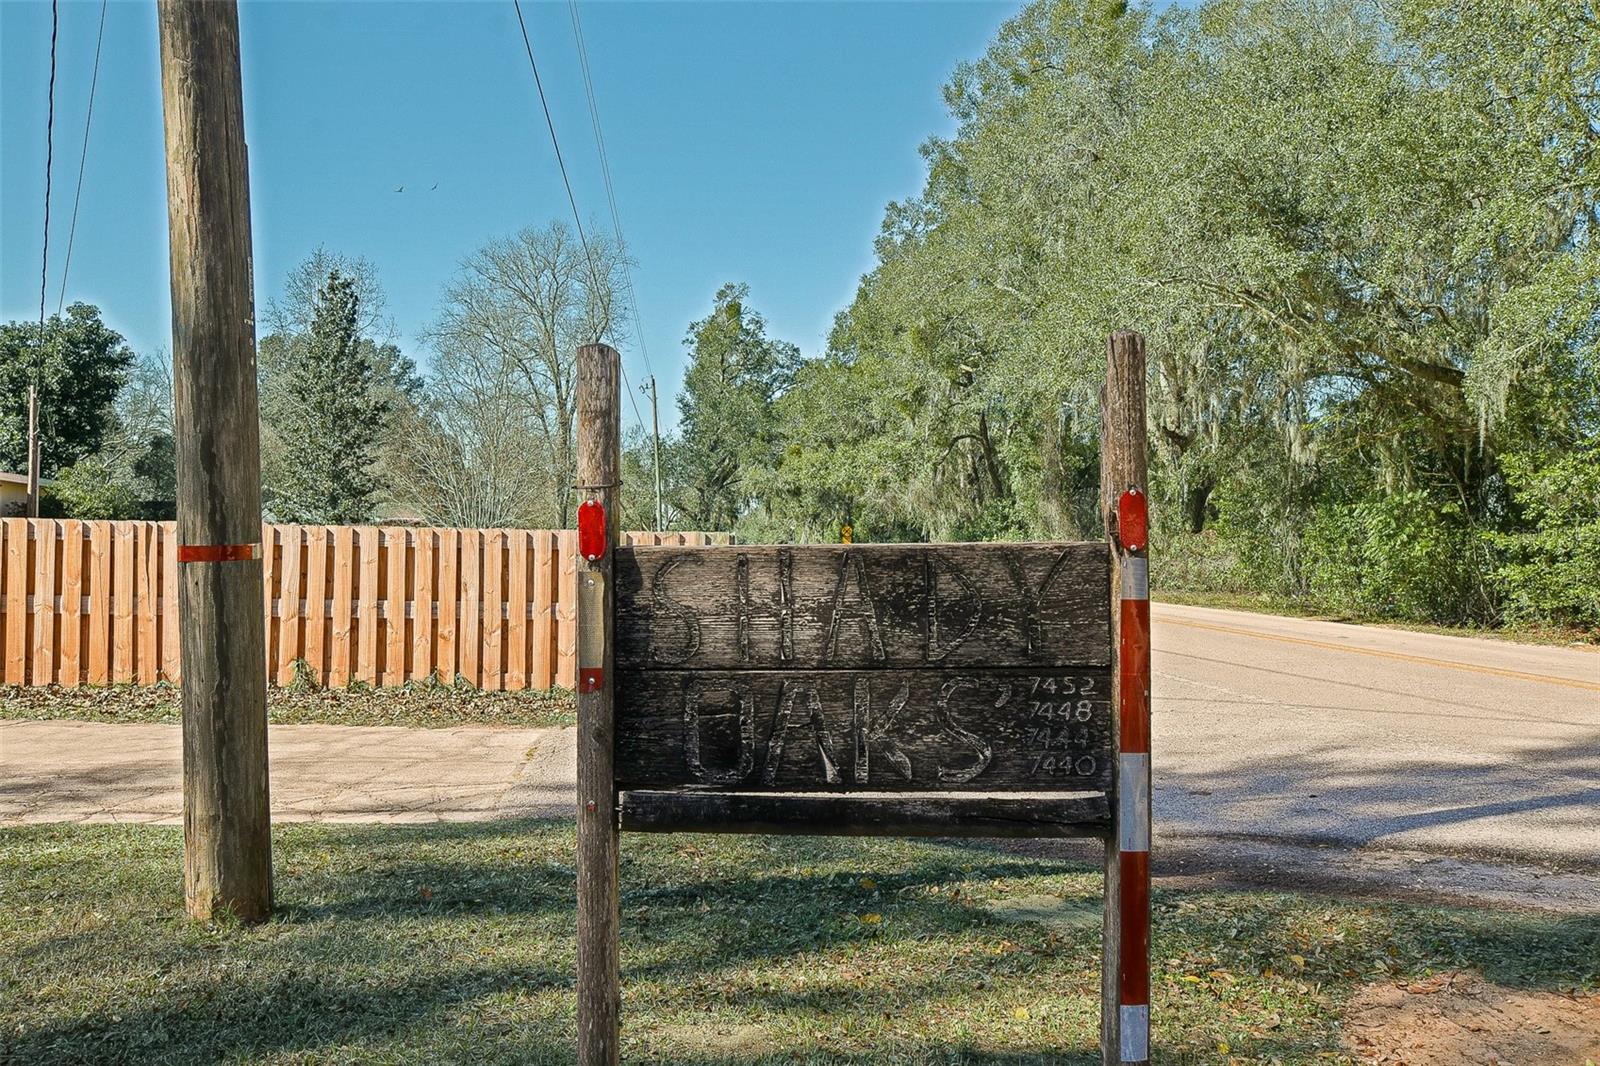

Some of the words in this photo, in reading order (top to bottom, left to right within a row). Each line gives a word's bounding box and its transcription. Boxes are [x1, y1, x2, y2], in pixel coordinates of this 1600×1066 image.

[652, 548, 1071, 664] SHADY
[1028, 676, 1098, 695] 7452
[1028, 700, 1092, 721] 7448
[1028, 755, 1096, 775] 7440
